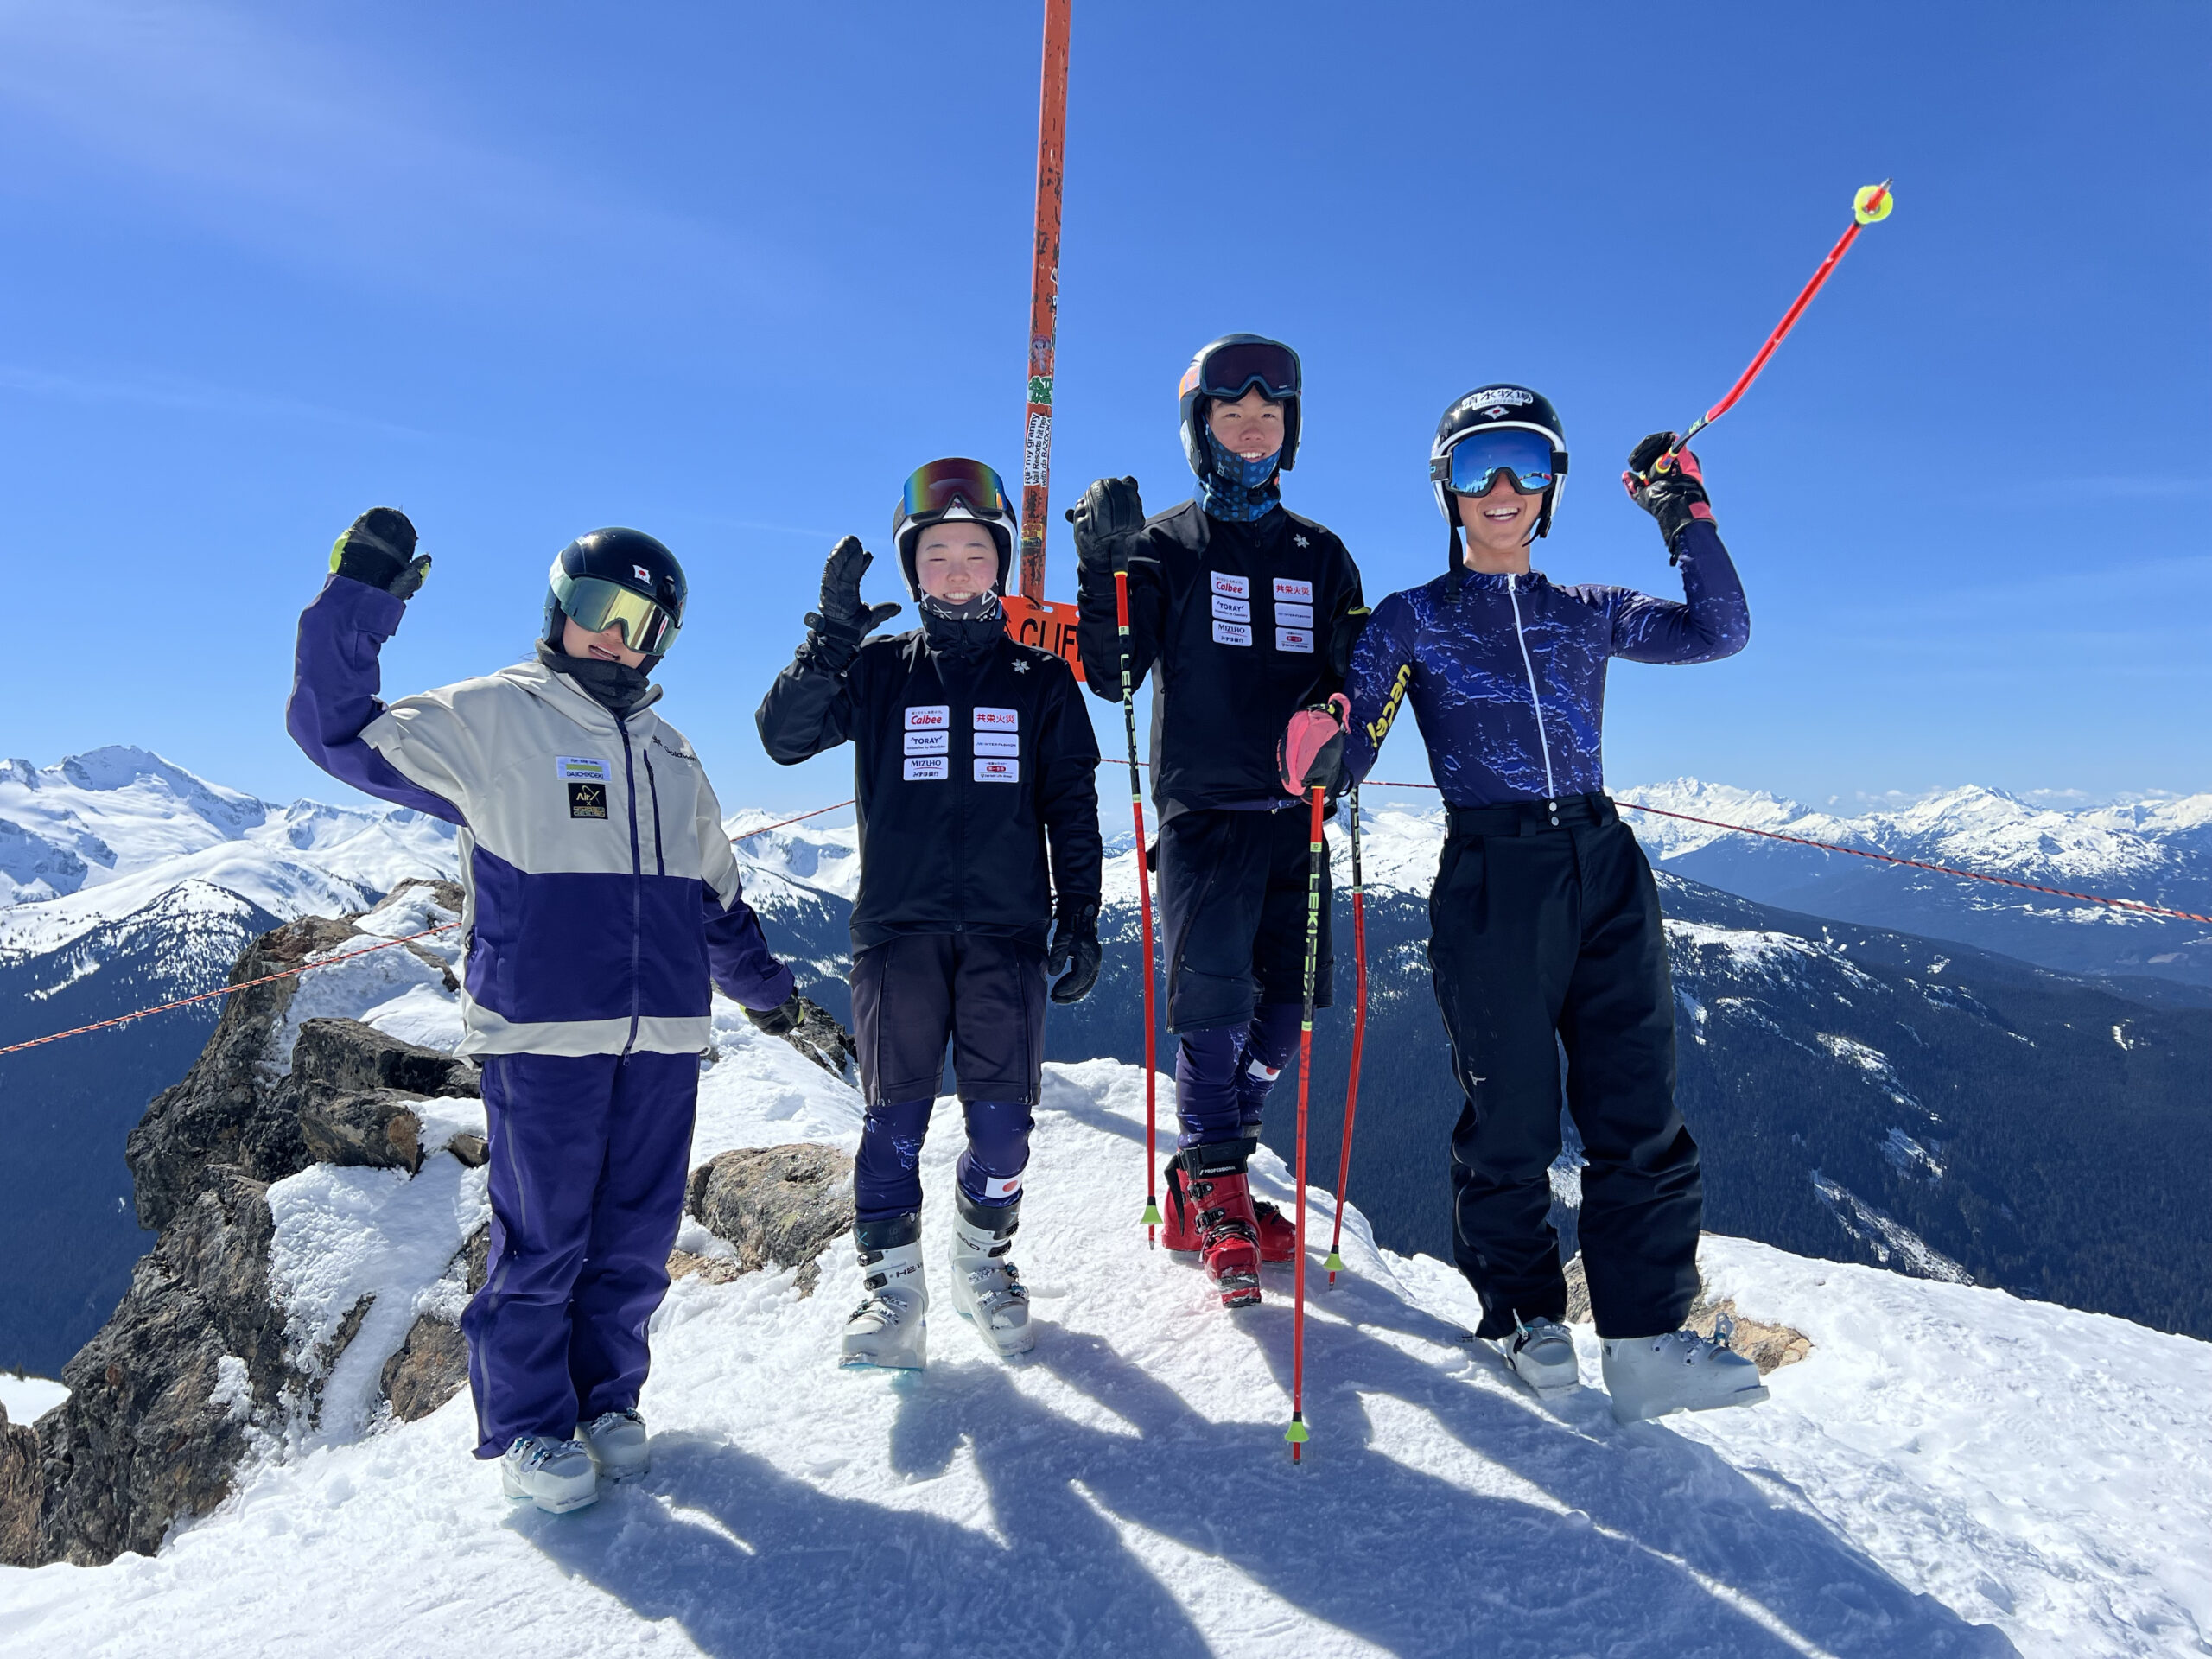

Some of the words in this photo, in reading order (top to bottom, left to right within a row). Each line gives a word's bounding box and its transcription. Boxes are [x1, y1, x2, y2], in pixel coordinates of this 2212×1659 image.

[1027, 414, 1040, 448] granny
[1041, 418, 1052, 458] BAZOOKA
[1026, 449, 1033, 465] my
[1033, 441, 1042, 469] Resorts
[1040, 459, 1046, 468] da
[1217, 581, 1243, 594] Calbee
[1217, 601, 1244, 612] TORAY
[1218, 624, 1245, 633] MIZUHO
[1020, 618, 1082, 663] CLIF
[1121, 654, 1133, 710] LEKI
[911, 715, 942, 725] Calbee
[911, 735, 942, 744] TORAY
[664, 745, 697, 763] Goldwin
[1307, 874, 1320, 934] LEKI
[1204, 1166, 1236, 1174] PROFESSIONAL
